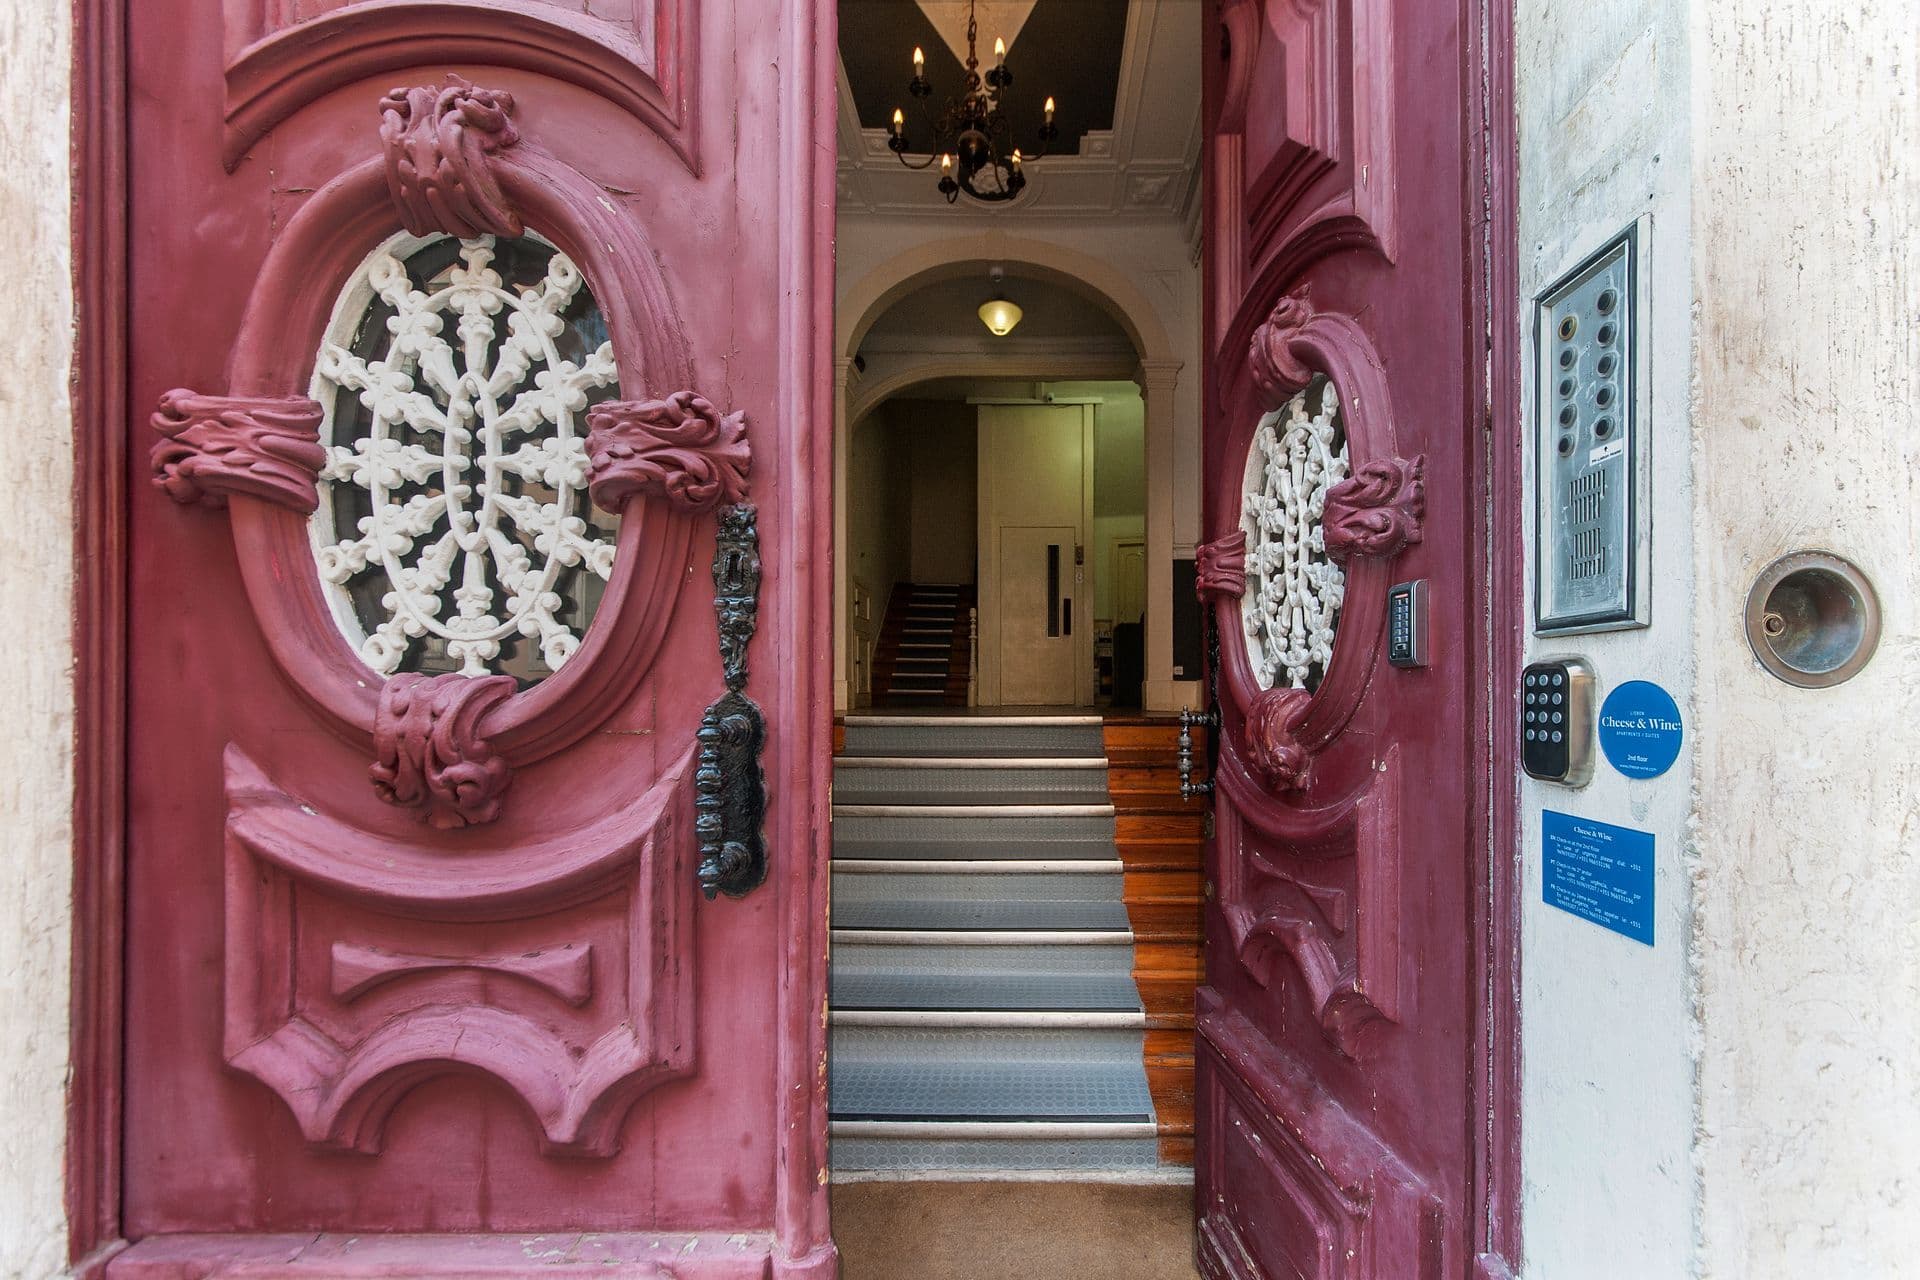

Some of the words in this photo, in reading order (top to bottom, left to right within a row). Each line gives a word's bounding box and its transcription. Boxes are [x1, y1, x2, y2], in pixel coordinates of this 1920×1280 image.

[1602, 716, 1635, 728] Cheese
[1636, 718, 1646, 728] &
[1573, 826, 1591, 835] Cheese
